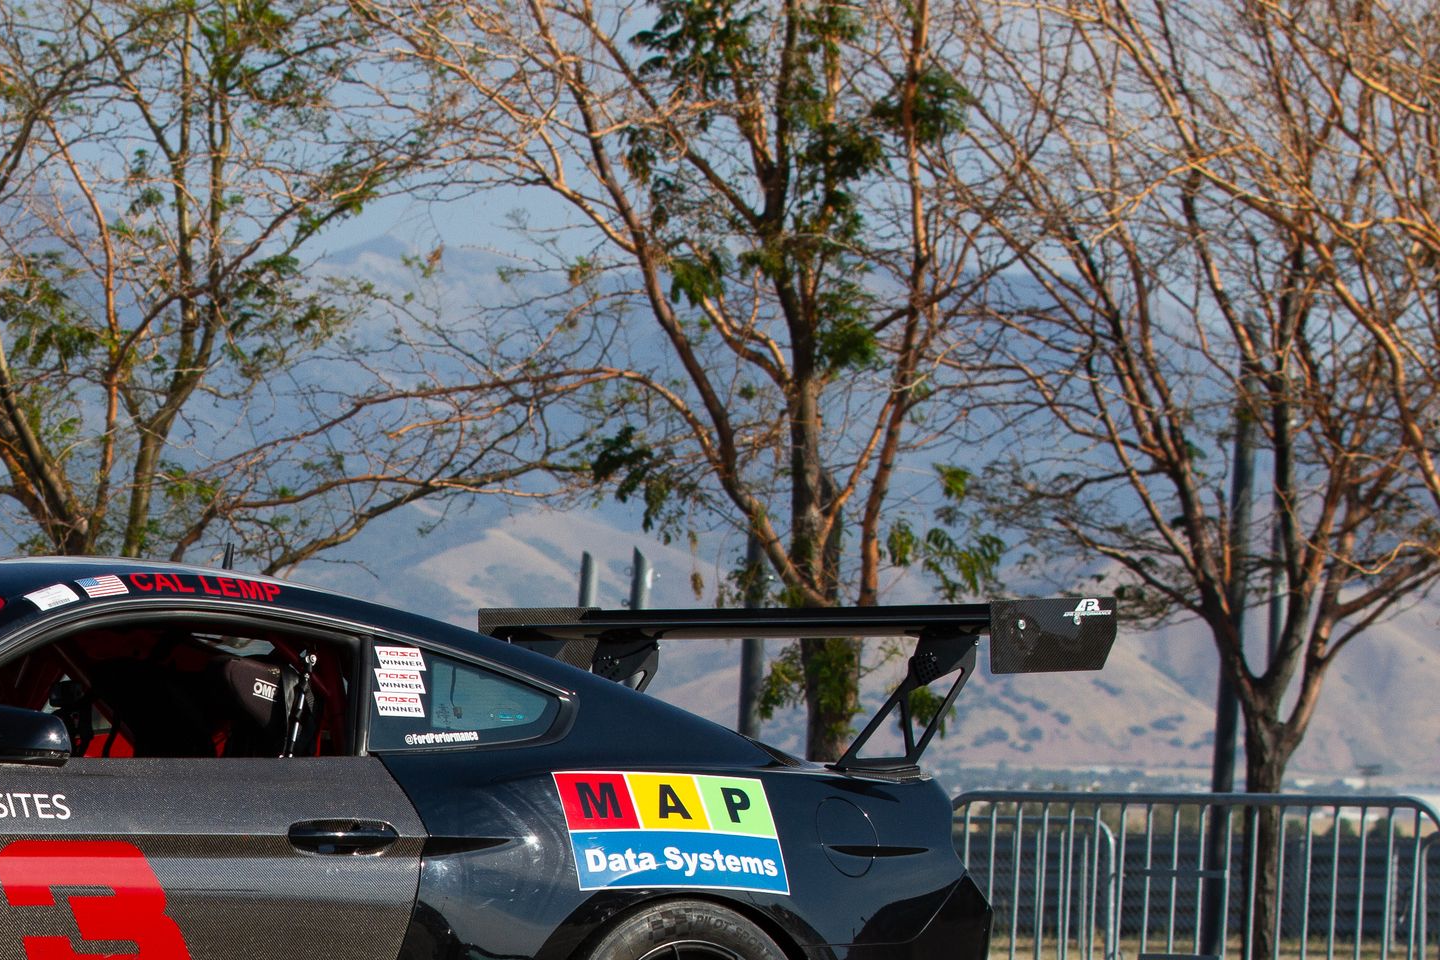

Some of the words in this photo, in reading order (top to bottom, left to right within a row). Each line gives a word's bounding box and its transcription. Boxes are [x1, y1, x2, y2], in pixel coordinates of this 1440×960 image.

[129, 573, 195, 593] CAL
[197, 575, 281, 601] LEMP
[380, 659, 423, 668] WINNER
[380, 681, 422, 690] WINNER
[378, 705, 422, 714] WINNER
[404, 730, 479, 746] @FordPerformance
[585, 848, 657, 873] Data
[664, 847, 778, 877] Systems
